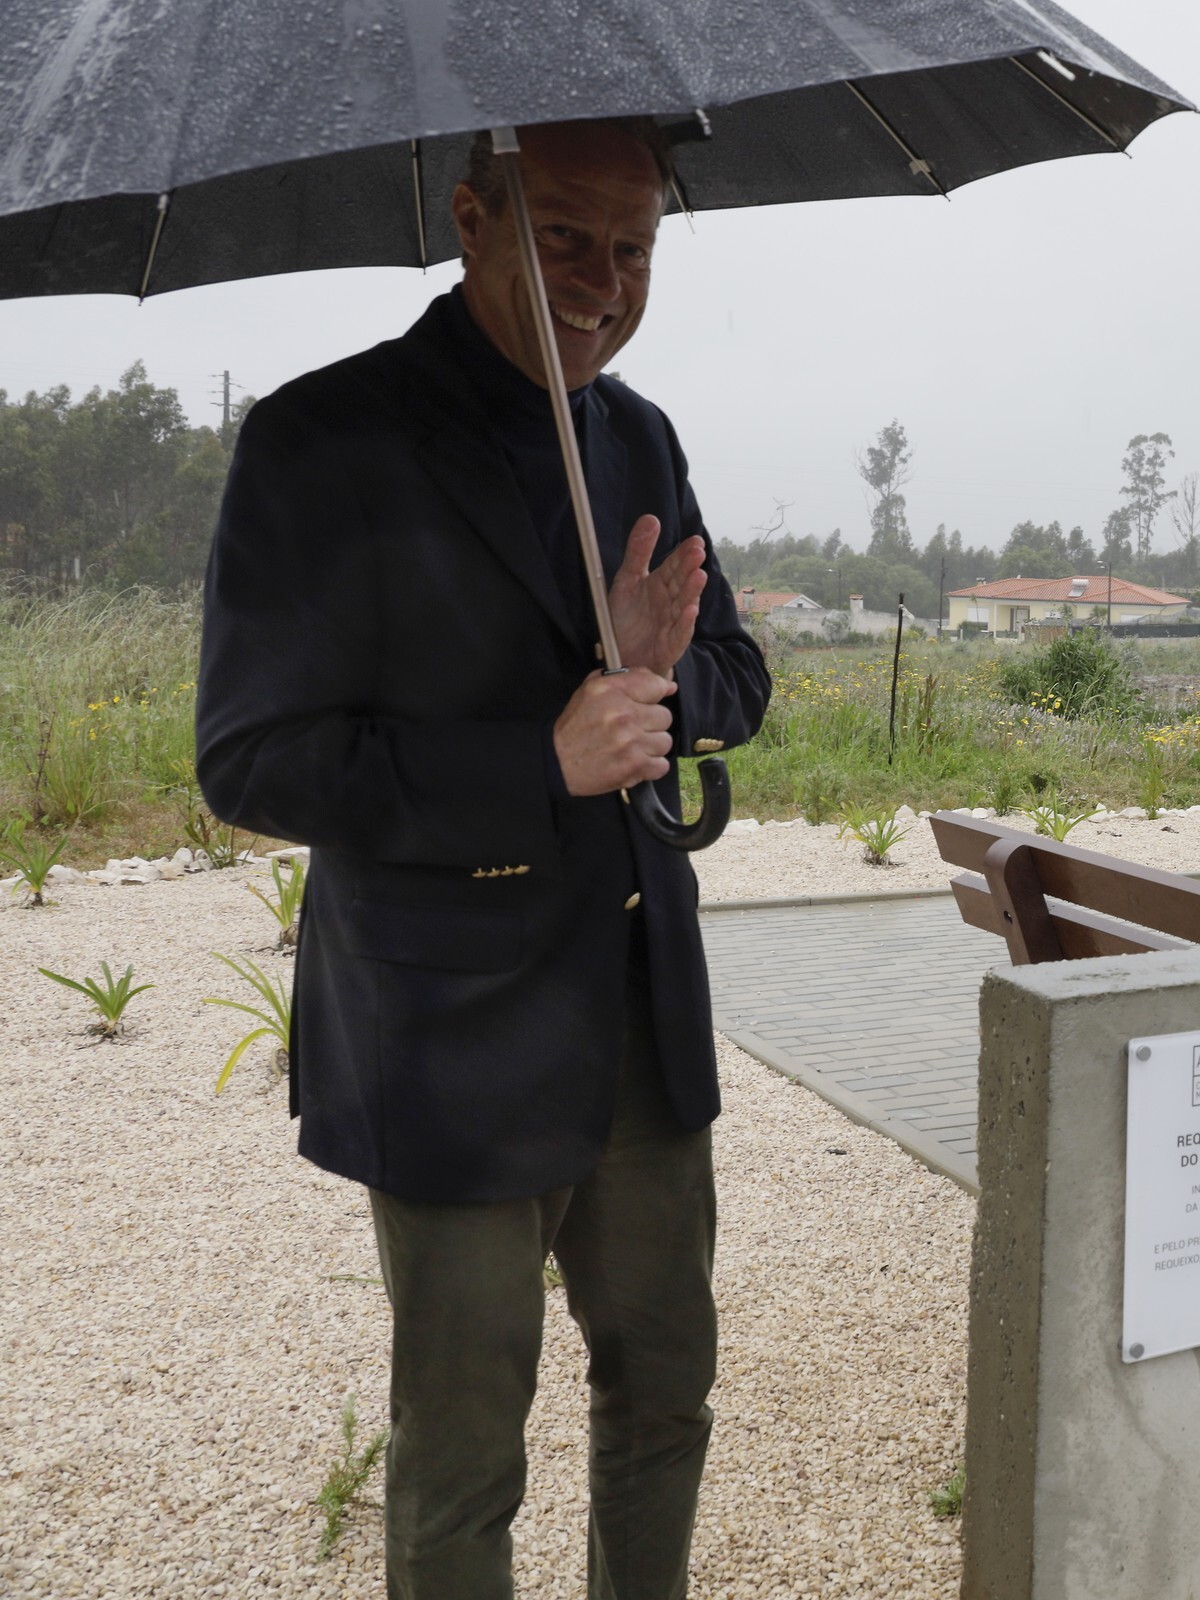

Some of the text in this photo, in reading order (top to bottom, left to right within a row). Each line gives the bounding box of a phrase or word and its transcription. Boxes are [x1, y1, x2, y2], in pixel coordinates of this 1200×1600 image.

[1181, 1154, 1198, 1167] DO
[1186, 1202, 1198, 1213] DA
[1154, 1244, 1160, 1254] E
[1162, 1240, 1186, 1253] PELO
